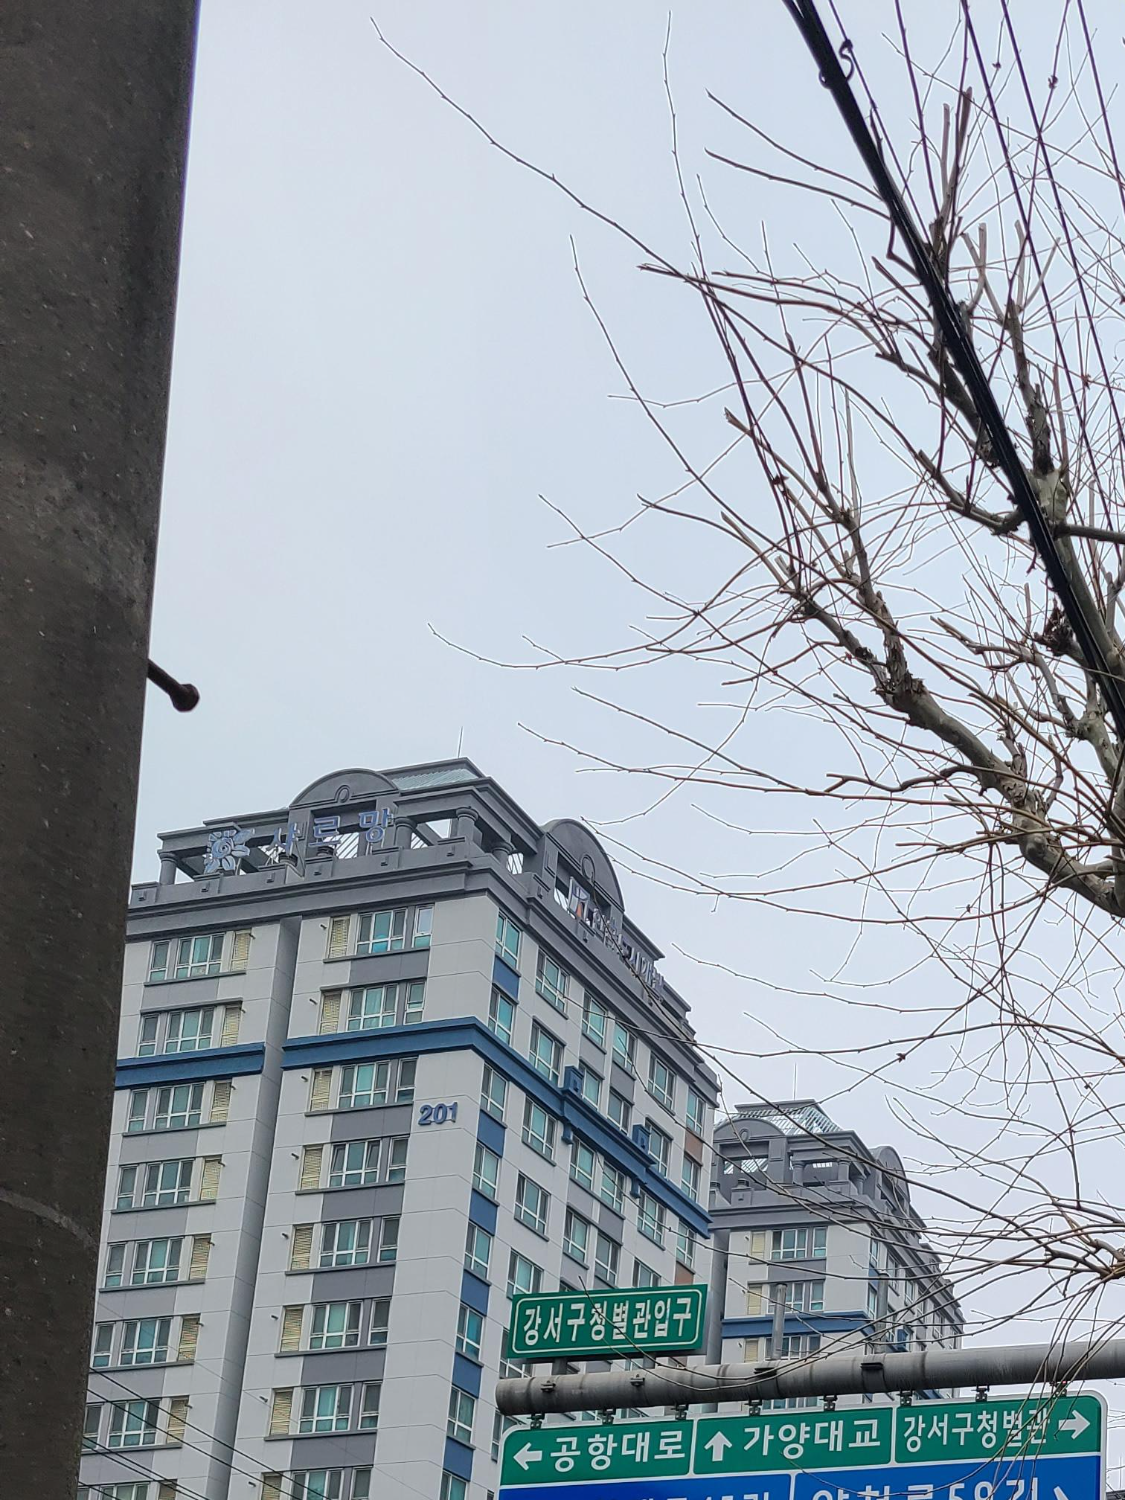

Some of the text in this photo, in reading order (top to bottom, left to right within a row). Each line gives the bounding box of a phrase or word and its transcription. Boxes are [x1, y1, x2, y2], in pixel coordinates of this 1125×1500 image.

[418, 1101, 458, 1125] 201
[522, 1297, 694, 1346] 강서구청별관입구
[743, 1416, 881, 1459] 가양대교
[904, 1405, 1049, 1453] 강서구청별관
[549, 1430, 686, 1474] 공항대로
